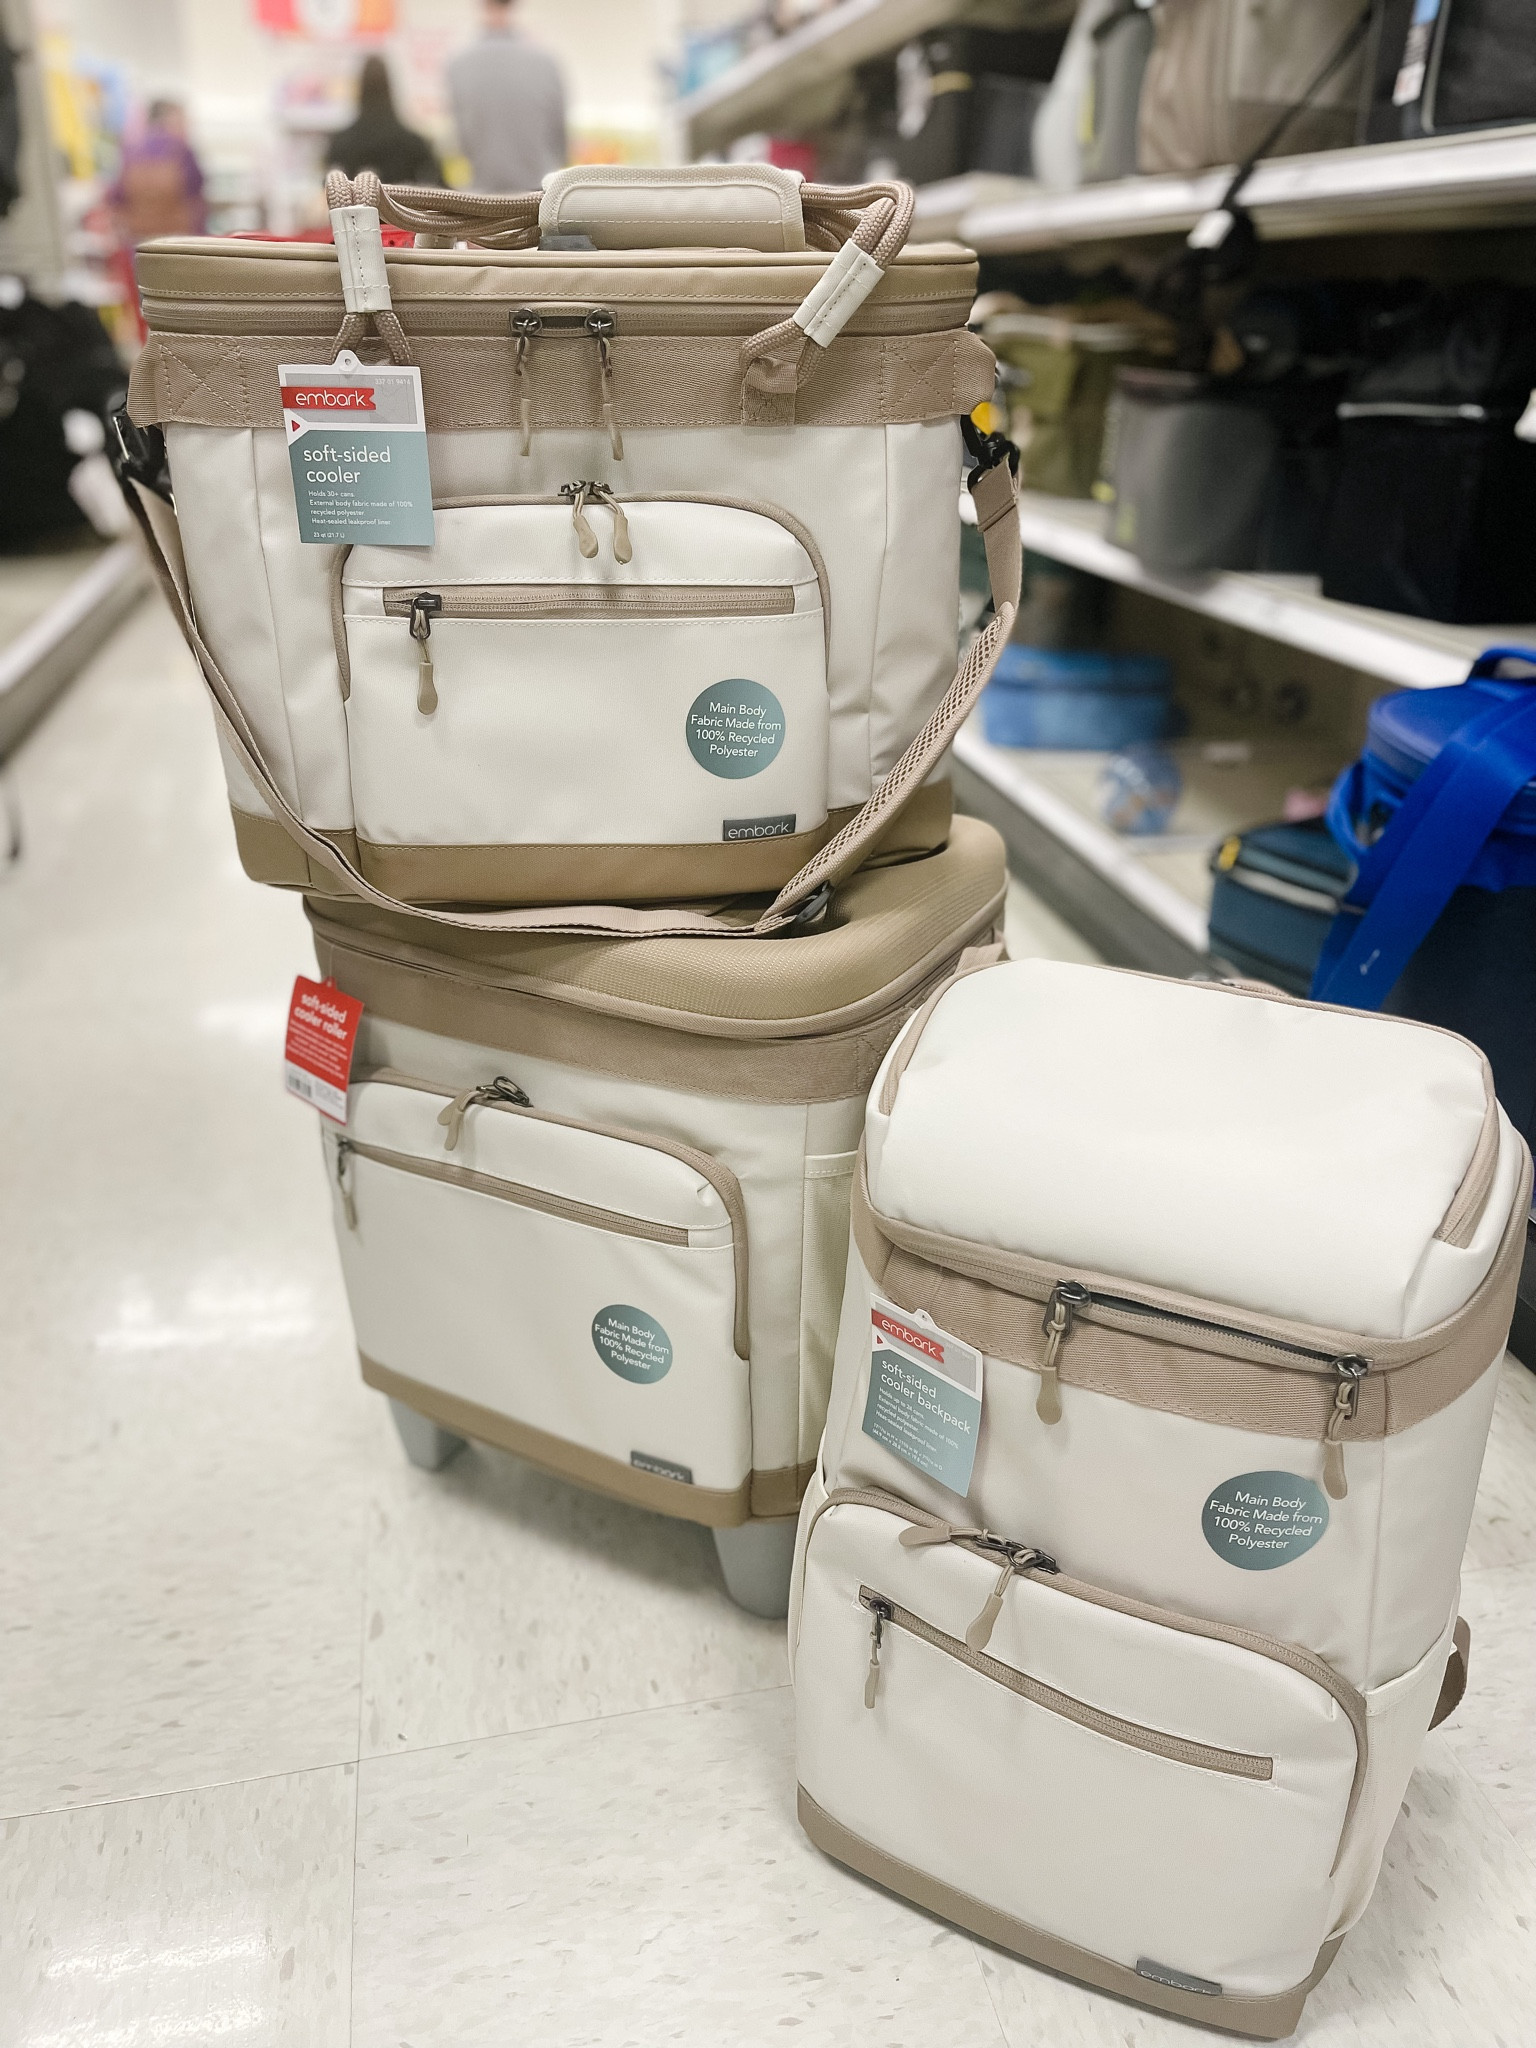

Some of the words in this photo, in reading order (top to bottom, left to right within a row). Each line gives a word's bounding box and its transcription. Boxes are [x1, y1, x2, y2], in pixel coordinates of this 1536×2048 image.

[296, 390, 366, 406] embark
[303, 444, 391, 463] soft-sided
[306, 466, 360, 483] cooler
[335, 500, 351, 508] body
[709, 702, 736, 714] Main
[739, 704, 766, 718] Body
[691, 714, 723, 727] Fabric
[725, 717, 755, 730] Made
[758, 719, 782, 731] from
[696, 729, 726, 742] 100%
[728, 732, 776, 746] Recycled
[710, 744, 758, 758] Polyester
[728, 822, 789, 838] embark
[594, 1323, 620, 1340] Fabric
[622, 1332, 647, 1348] Made
[648, 1341, 670, 1354] from
[608, 1318, 630, 1332] Main
[632, 1325, 656, 1341] Body
[882, 1319, 937, 1357] embark
[600, 1336, 623, 1352] 100%
[625, 1345, 664, 1364] Recycled
[611, 1350, 652, 1370] Polyester
[882, 1360, 936, 1399] soft-sided
[881, 1374, 915, 1400] cooler
[917, 1392, 972, 1436] backpack
[1235, 1491, 1268, 1506] Main
[1272, 1496, 1306, 1511] Body
[1210, 1500, 1250, 1518] Fabric
[1252, 1509, 1290, 1522] Made
[1292, 1511, 1323, 1524] from
[1214, 1516, 1251, 1533] 100%
[1254, 1523, 1313, 1538] Recycled
[1228, 1534, 1290, 1550] Polyester
